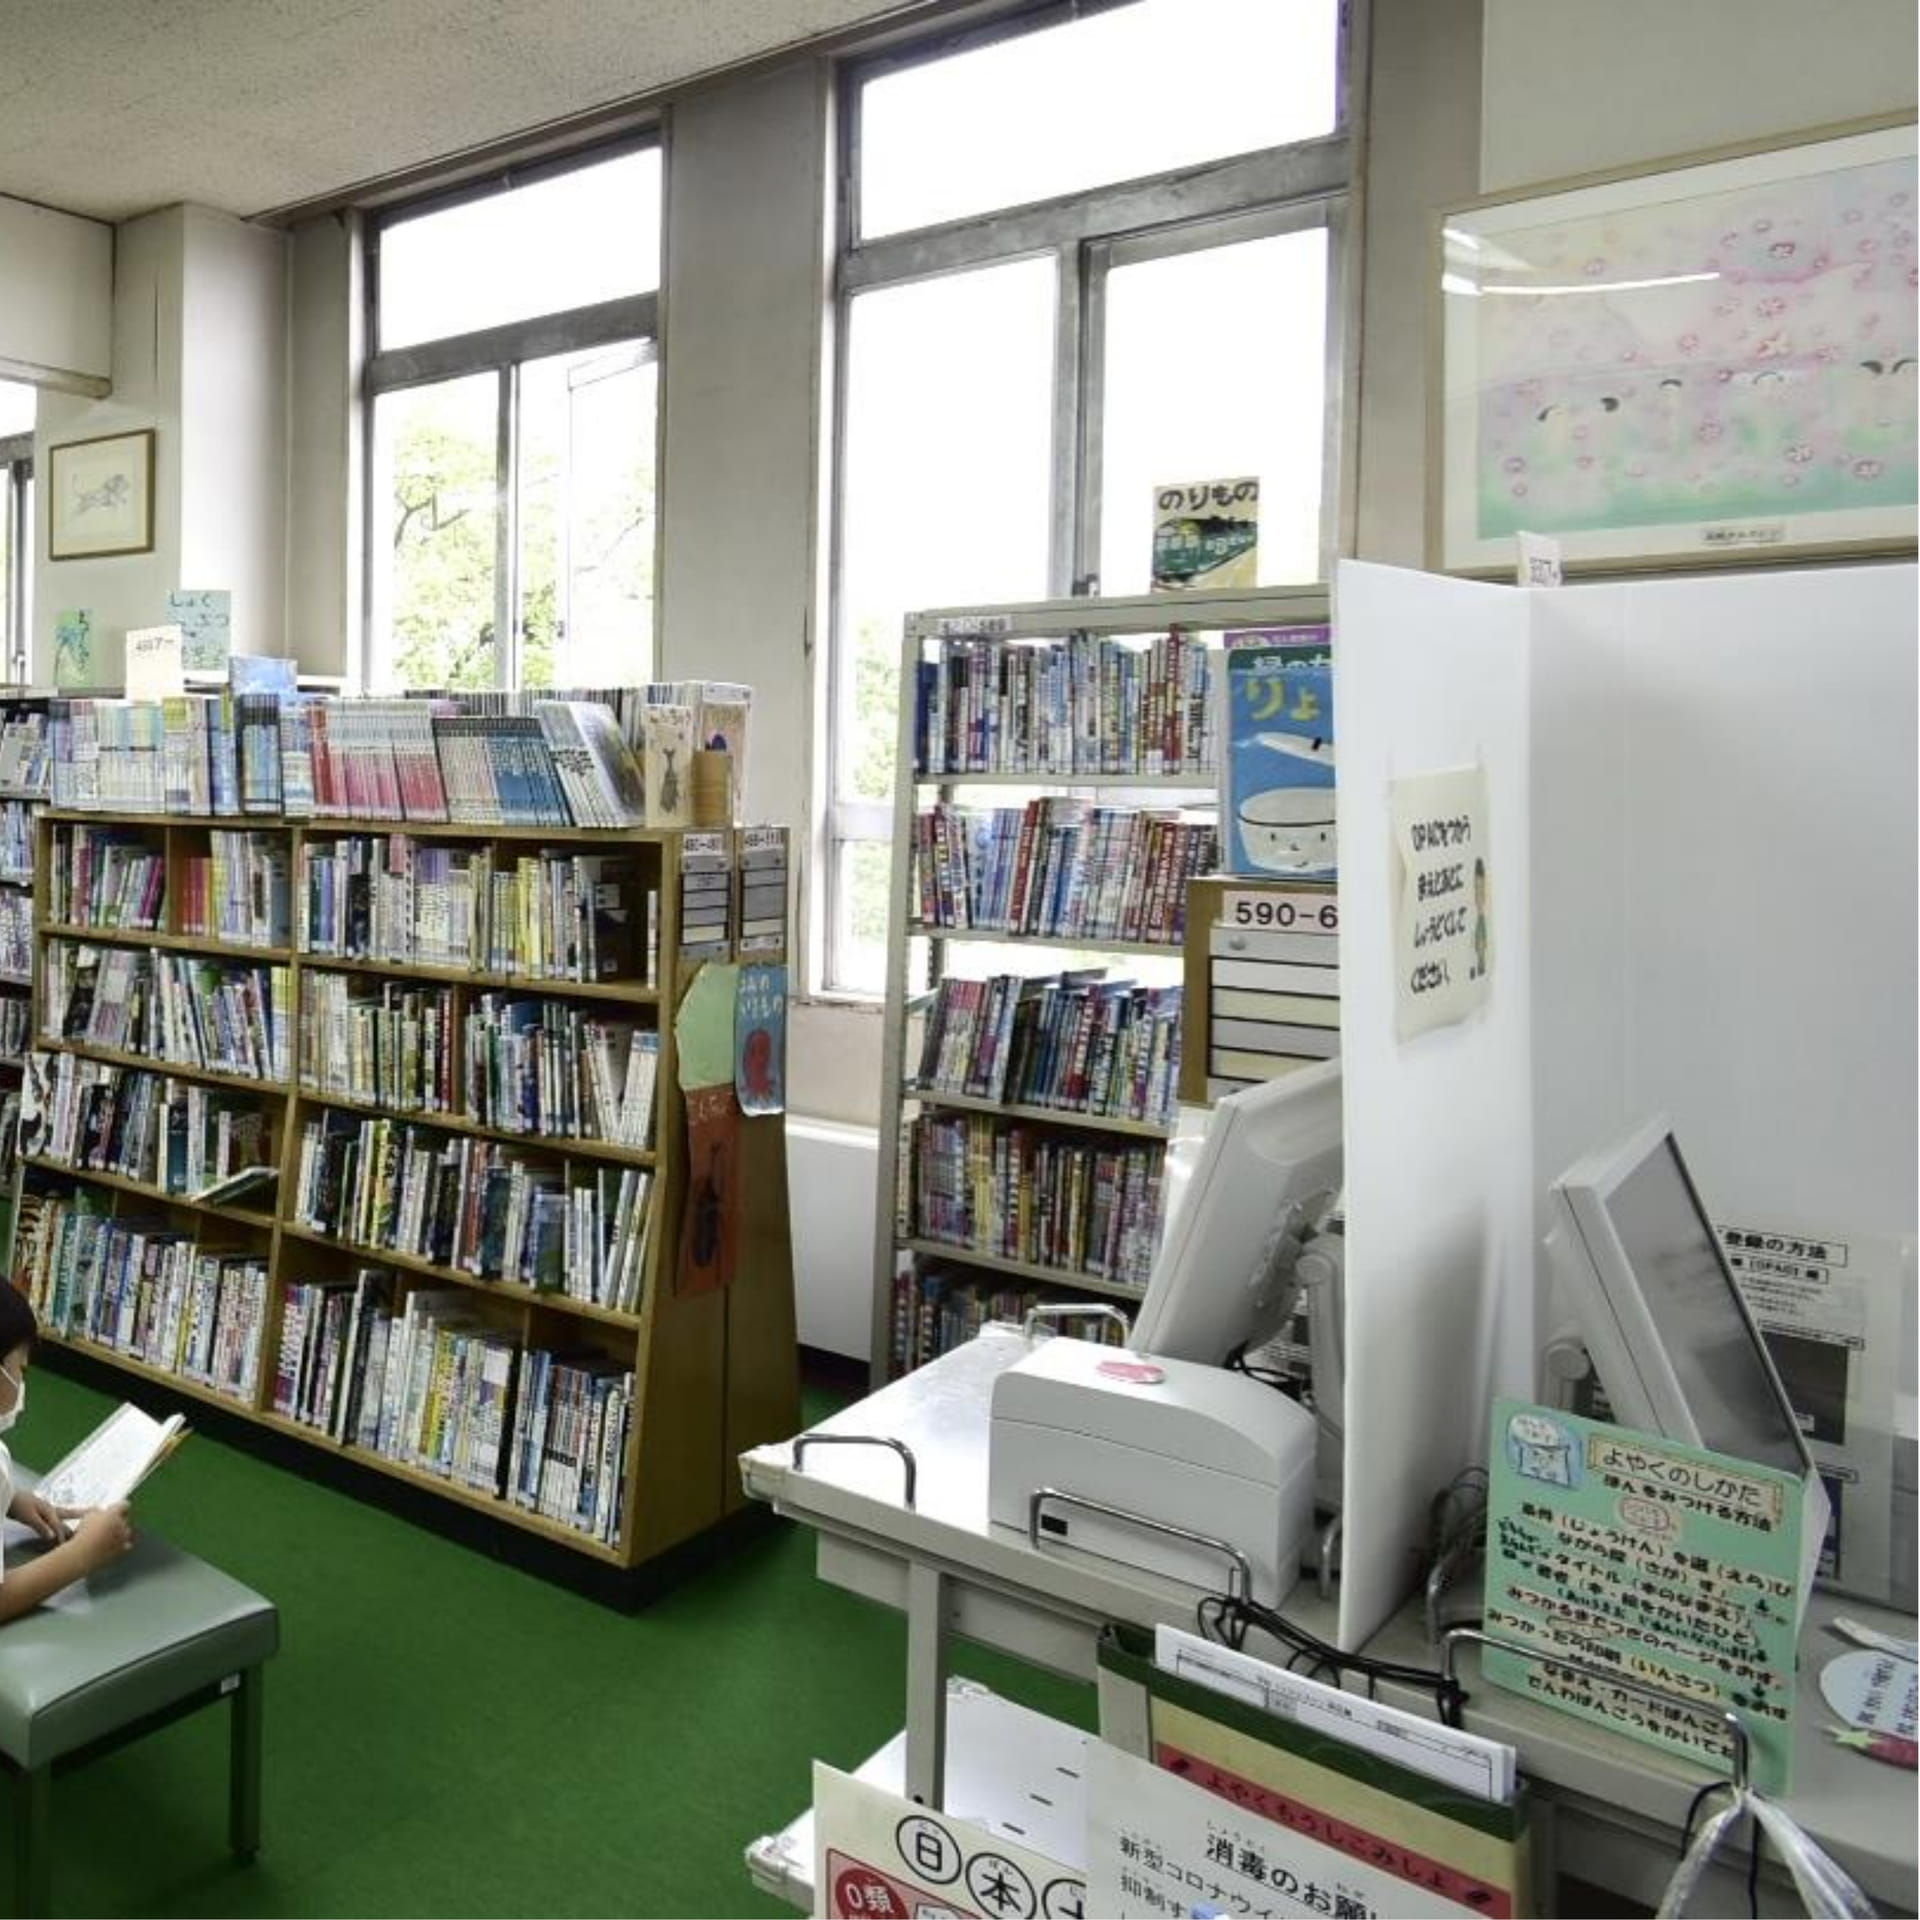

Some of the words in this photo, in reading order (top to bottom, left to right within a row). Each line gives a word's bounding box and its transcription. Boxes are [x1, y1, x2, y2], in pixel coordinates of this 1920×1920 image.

[1158, 481, 1258, 511] のりもの
[1603, 1447, 1762, 1508] よやくのしかた
